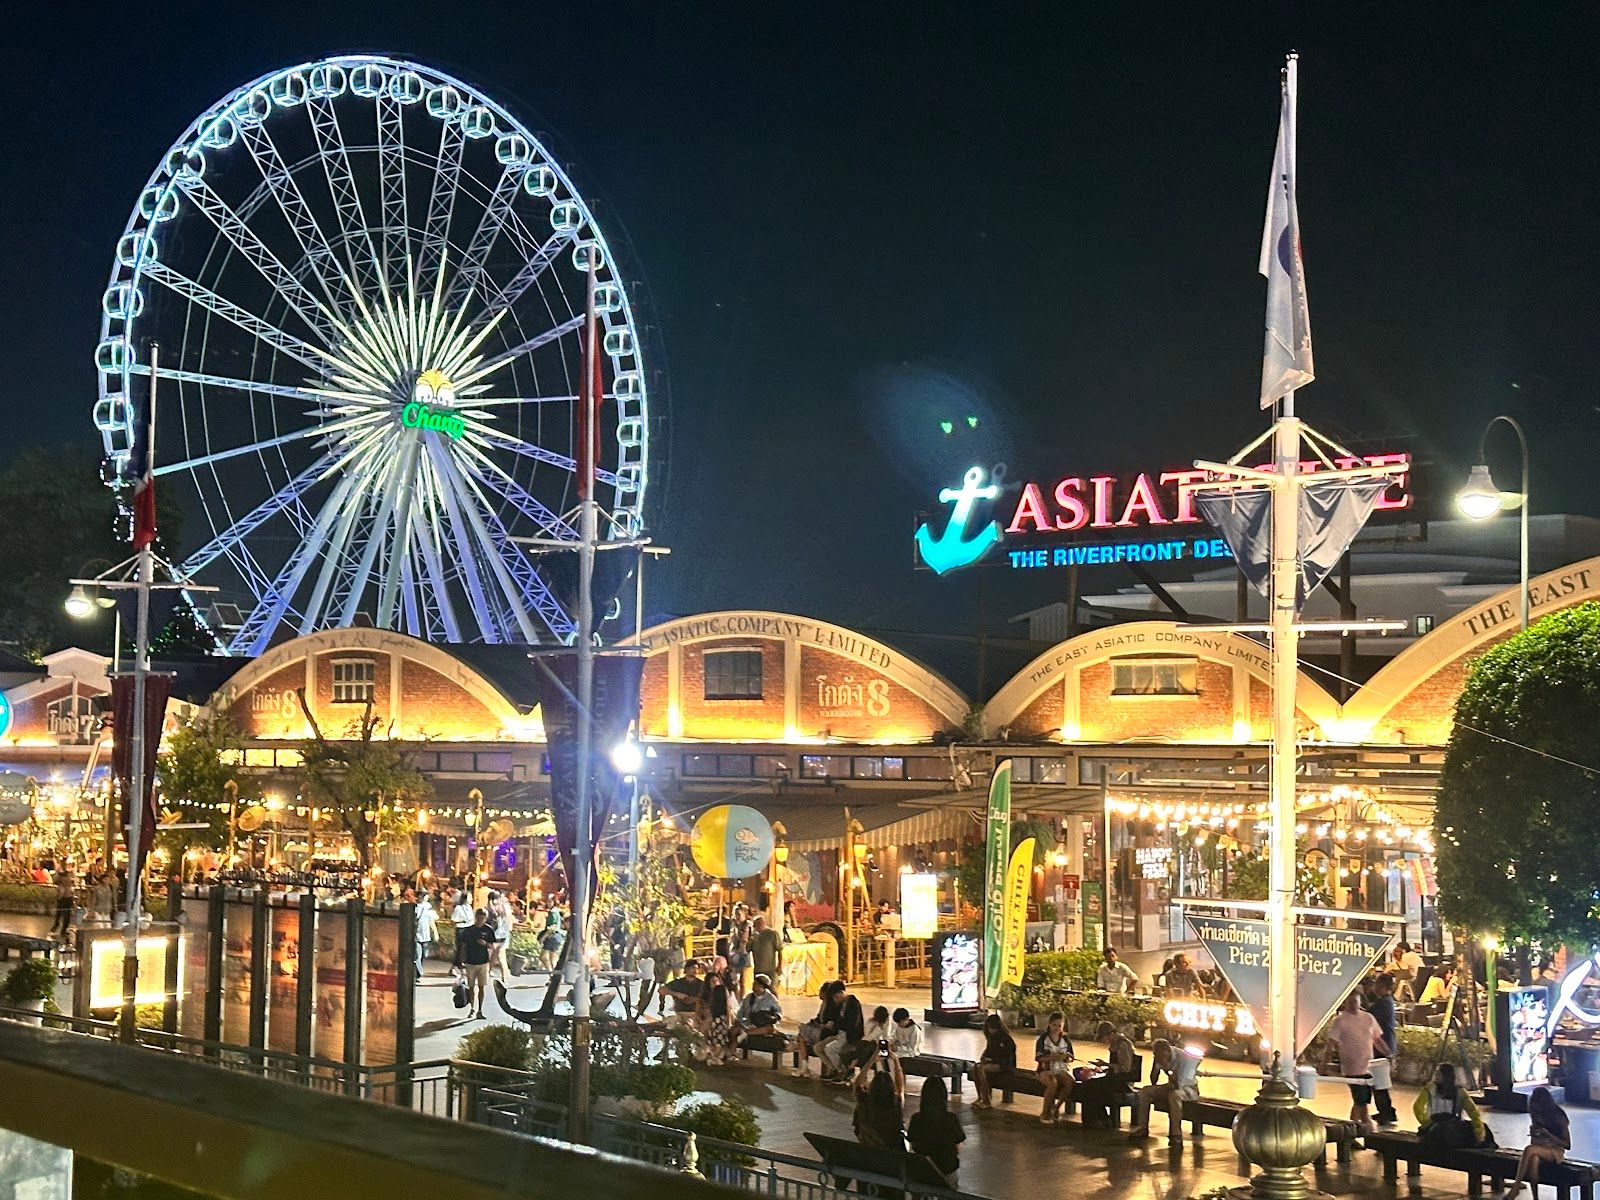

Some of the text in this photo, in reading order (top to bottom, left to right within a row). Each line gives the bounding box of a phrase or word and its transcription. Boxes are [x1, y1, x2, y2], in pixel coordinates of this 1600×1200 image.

[402, 402, 465, 440] Chang
[1004, 454, 1408, 532] ASIATE
[1008, 549, 1048, 568] THE
[1053, 541, 1186, 566] RIVERFRONT
[1463, 569, 1591, 636] THE EAST
[661, 618, 720, 644] ASIATIC
[727, 616, 804, 637] COMPANY
[815, 627, 891, 669] LIMITED
[1030, 632, 1271, 683] THE EAST ASIATIC COMPANY LIMITE
[281, 689, 297, 720] 8
[816, 674, 891, 718] โกดัง 8
[1229, 946, 1270, 968] Pier 2
[1297, 953, 1342, 976] Pier 2
[1163, 1000, 1227, 1032] CHIT
